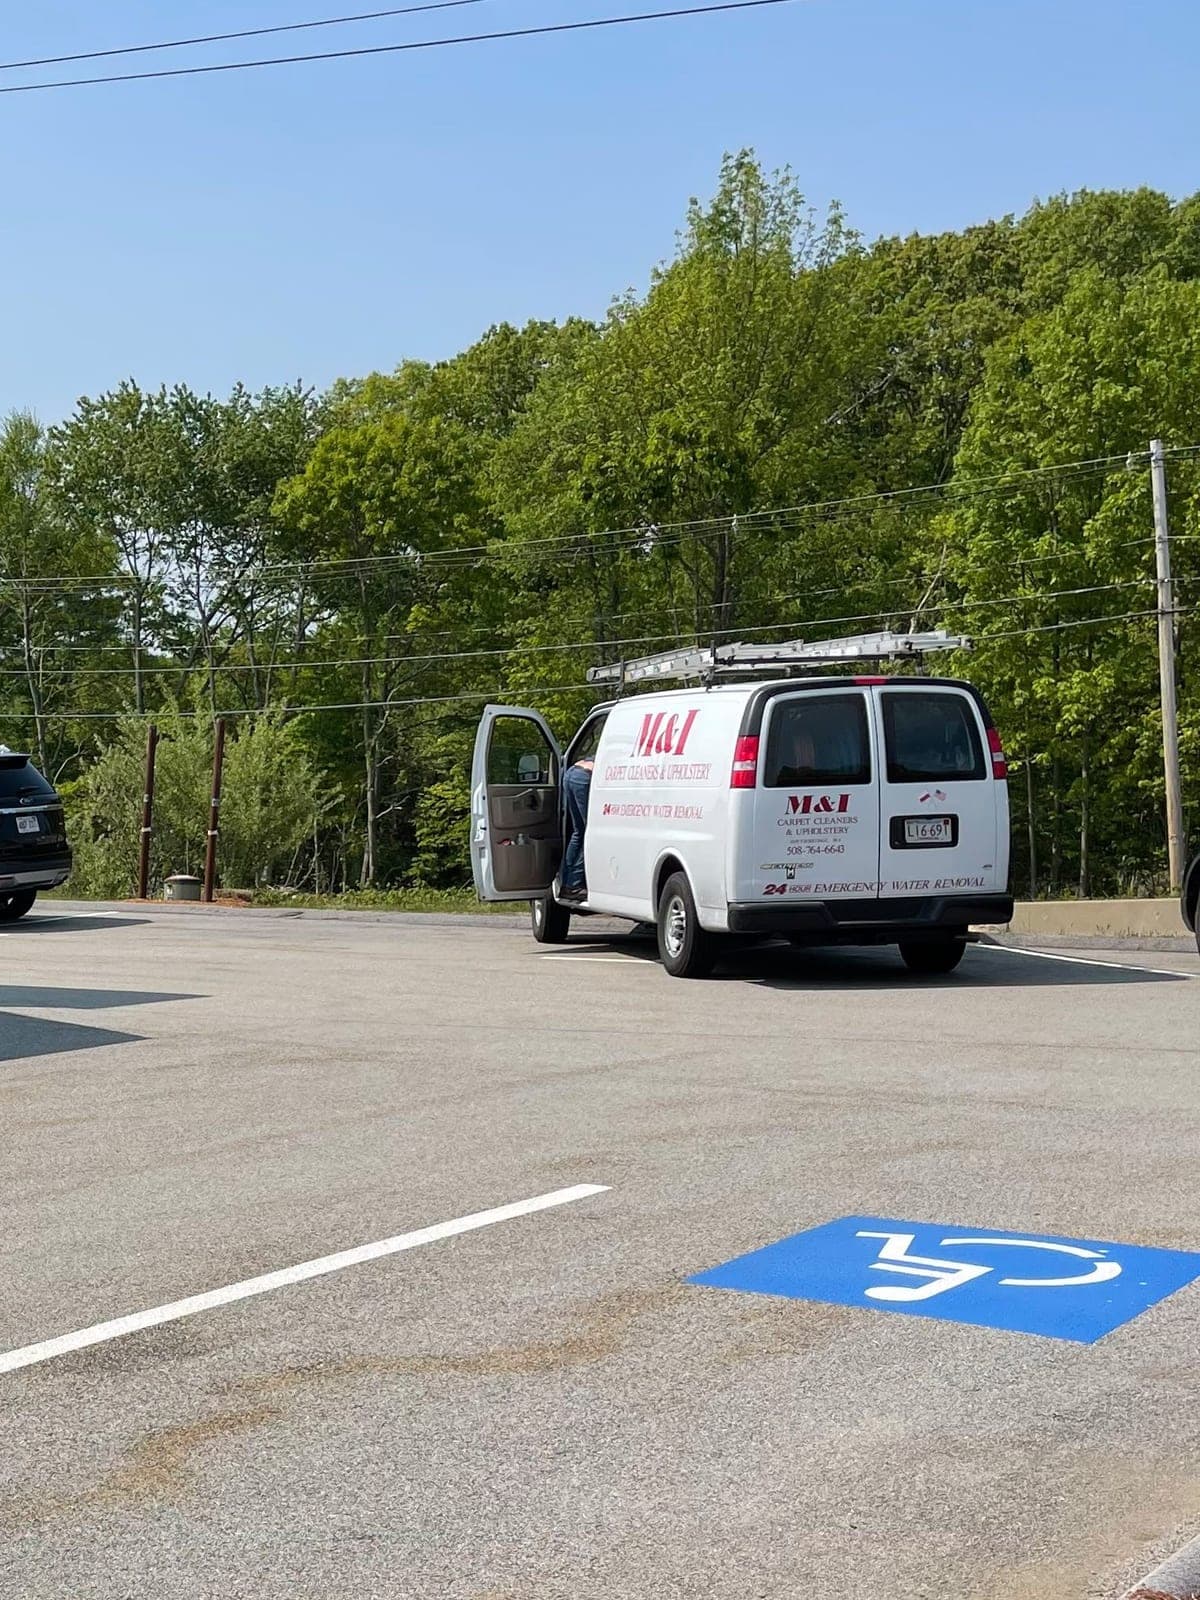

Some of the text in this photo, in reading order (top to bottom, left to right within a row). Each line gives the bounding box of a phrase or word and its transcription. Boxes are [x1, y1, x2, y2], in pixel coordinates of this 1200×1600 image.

[629, 709, 701, 758] M&I
[605, 765, 627, 781] CARPET
[628, 764, 659, 780] CLEANERS
[667, 763, 711, 780] UPHOLSTERY
[785, 793, 852, 815] M&I
[777, 816, 858, 827] CARPET CLEANERS
[785, 826, 848, 836] & UPHOLSTERY
[786, 844, 846, 856] 508-764-6643
[763, 883, 788, 896] 24
[814, 881, 888, 893] EMERGENCY
[892, 879, 931, 891] WATER
[934, 877, 985, 889] REMOVAL
